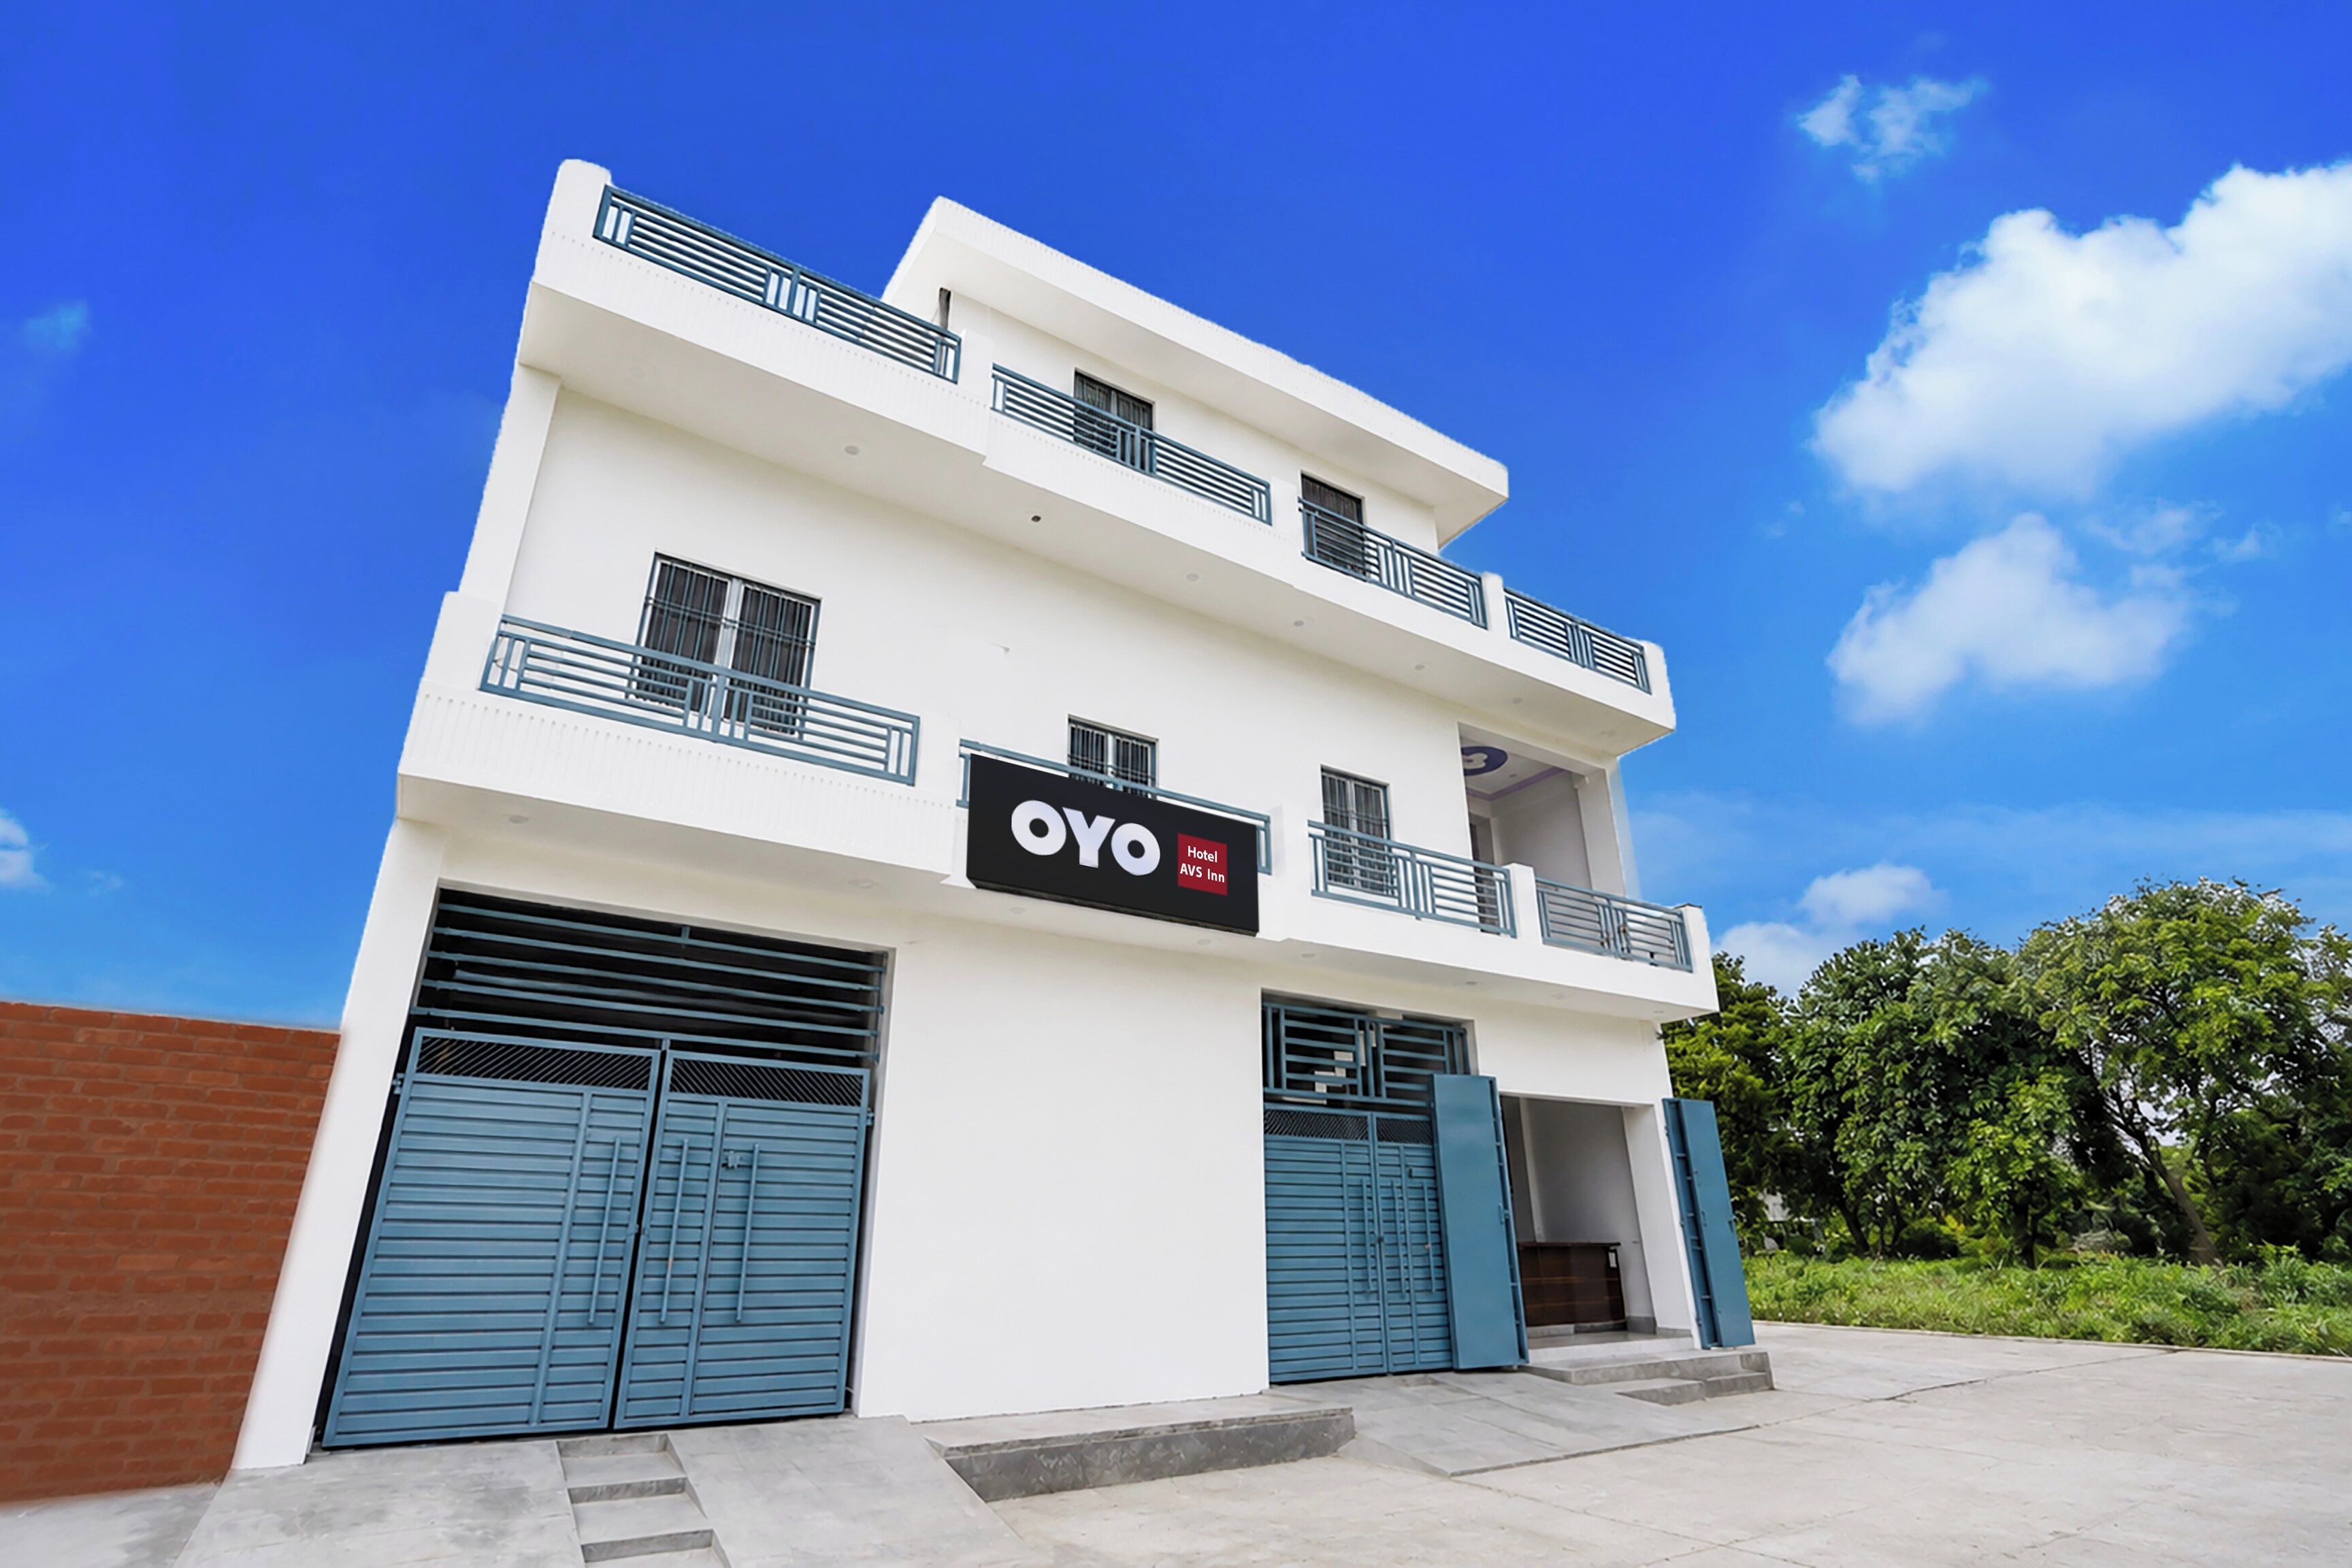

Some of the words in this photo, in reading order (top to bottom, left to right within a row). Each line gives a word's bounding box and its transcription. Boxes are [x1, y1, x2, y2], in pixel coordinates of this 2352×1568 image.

[1011, 800, 1161, 876] OYO
[1187, 845, 1218, 863] Hotel
[1179, 863, 1203, 878] AVS
[1207, 868, 1225, 883] Inn
